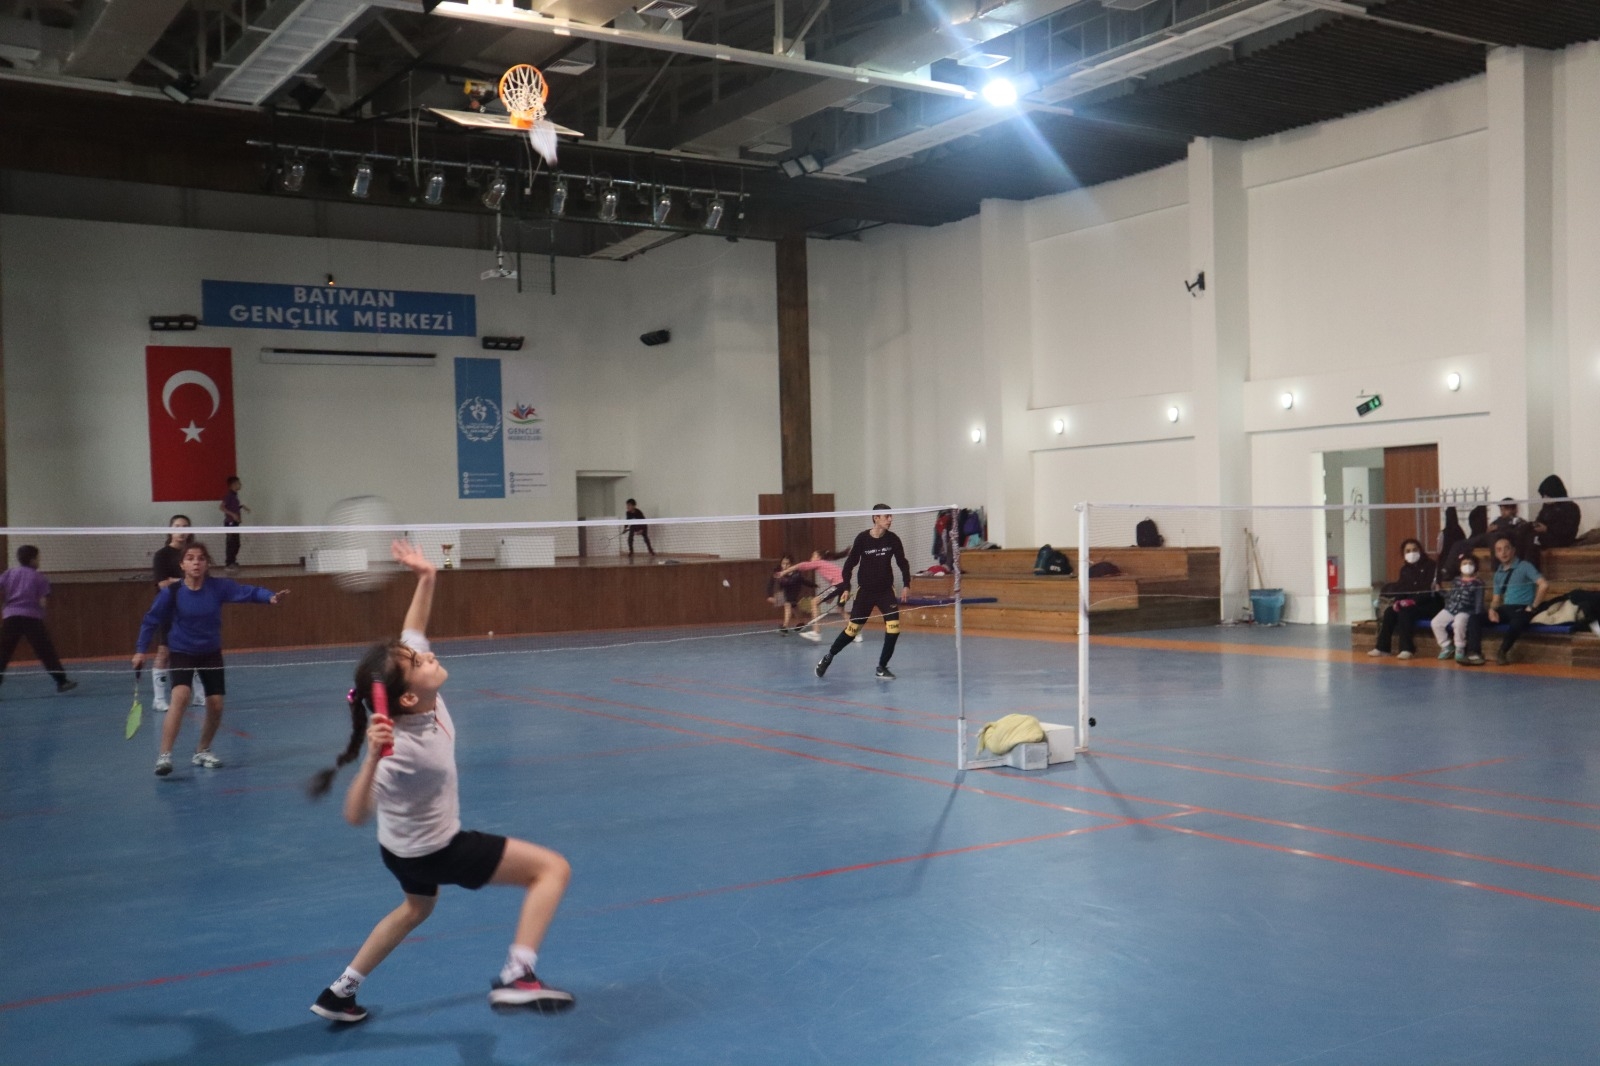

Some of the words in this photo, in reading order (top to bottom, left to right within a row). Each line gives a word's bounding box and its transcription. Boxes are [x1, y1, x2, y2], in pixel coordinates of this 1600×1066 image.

[293, 286, 395, 308] BATMAN
[229, 304, 339, 328] GENÇLİK
[353, 310, 453, 330] MERKEZİ
